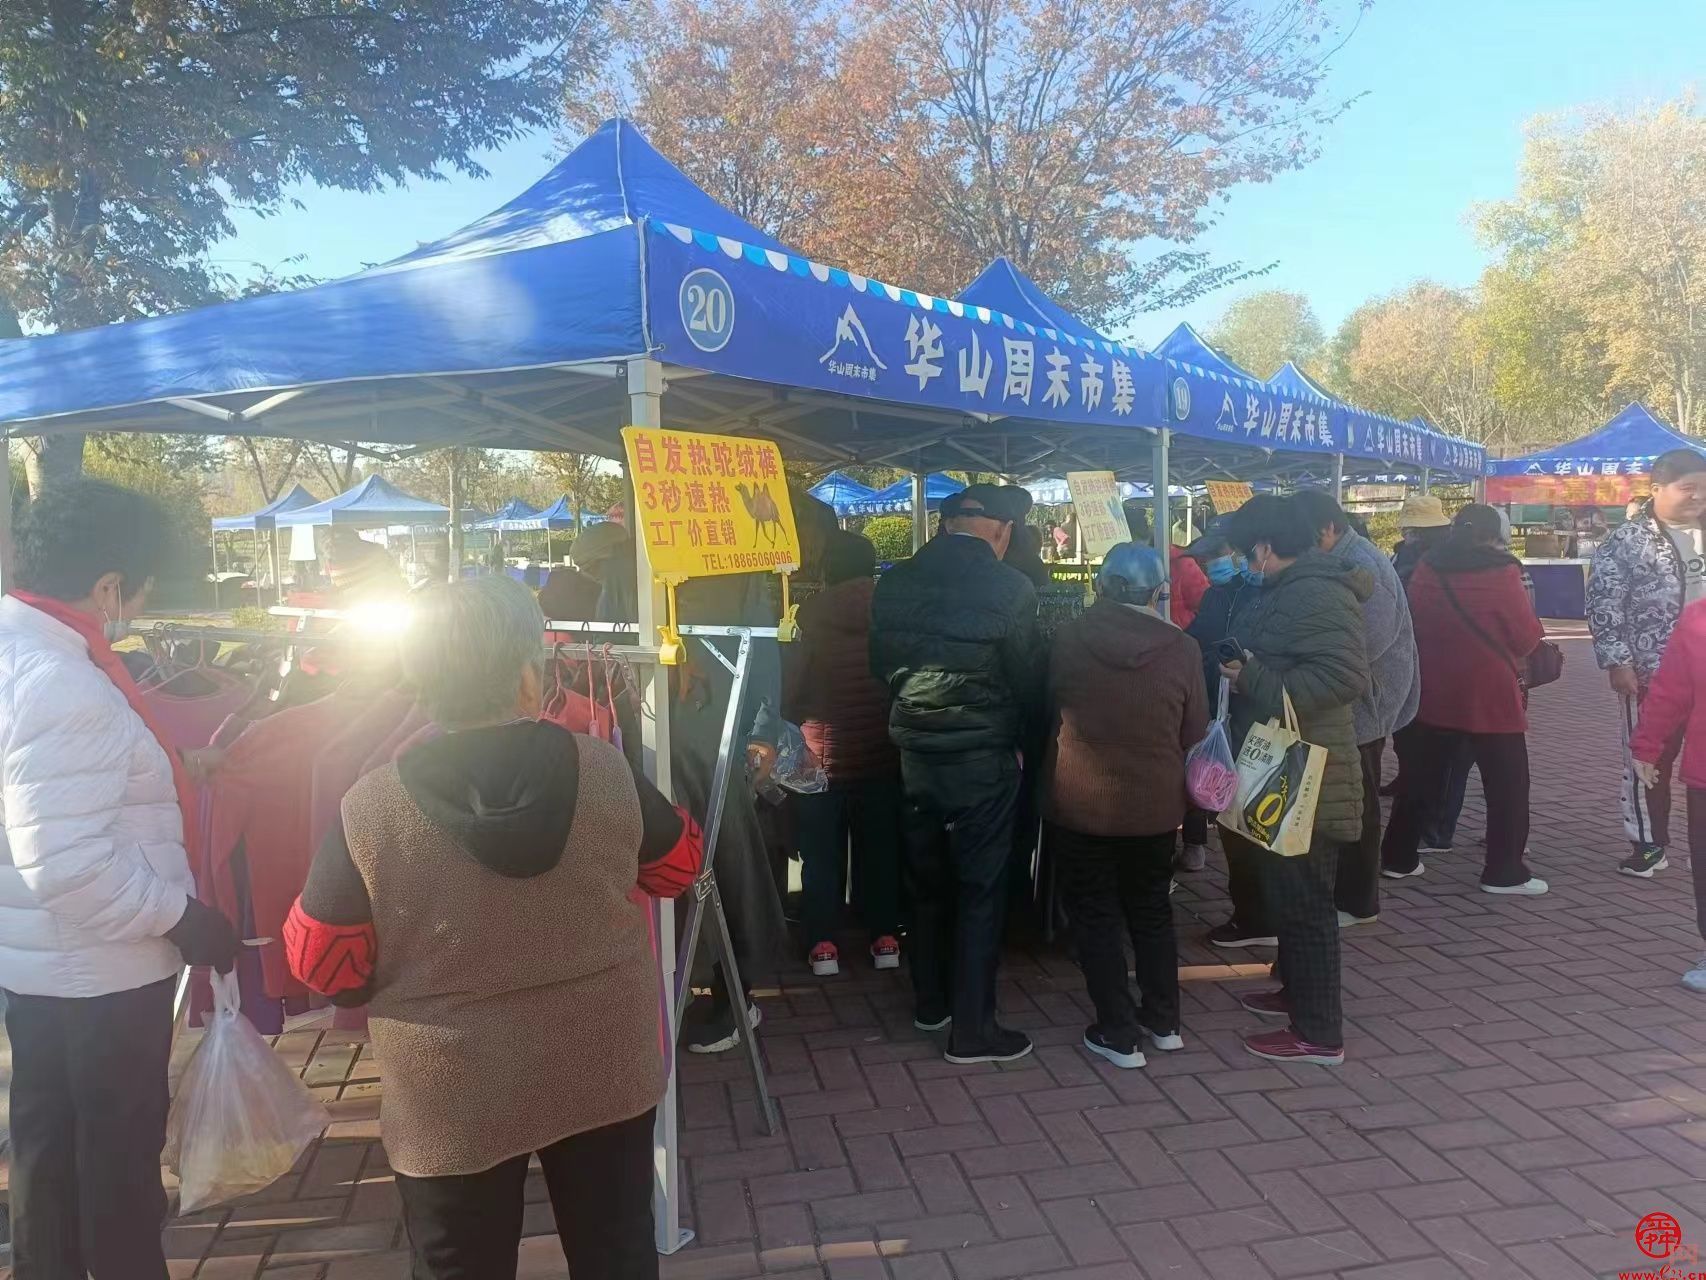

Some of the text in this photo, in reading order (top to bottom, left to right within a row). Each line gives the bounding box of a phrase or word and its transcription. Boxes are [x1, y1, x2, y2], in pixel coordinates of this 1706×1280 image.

[687, 284, 726, 334] 20
[827, 359, 877, 382] 华山周末市集
[903, 313, 1137, 416] 华山周末市集
[1243, 393, 1335, 447] 华山周末市集
[634, 432, 779, 480] 自发热驼绒裤
[1554, 461, 1653, 476] 华山周末
[640, 480, 731, 514] 3秒速热
[650, 518, 737, 548] 工厂价直销
